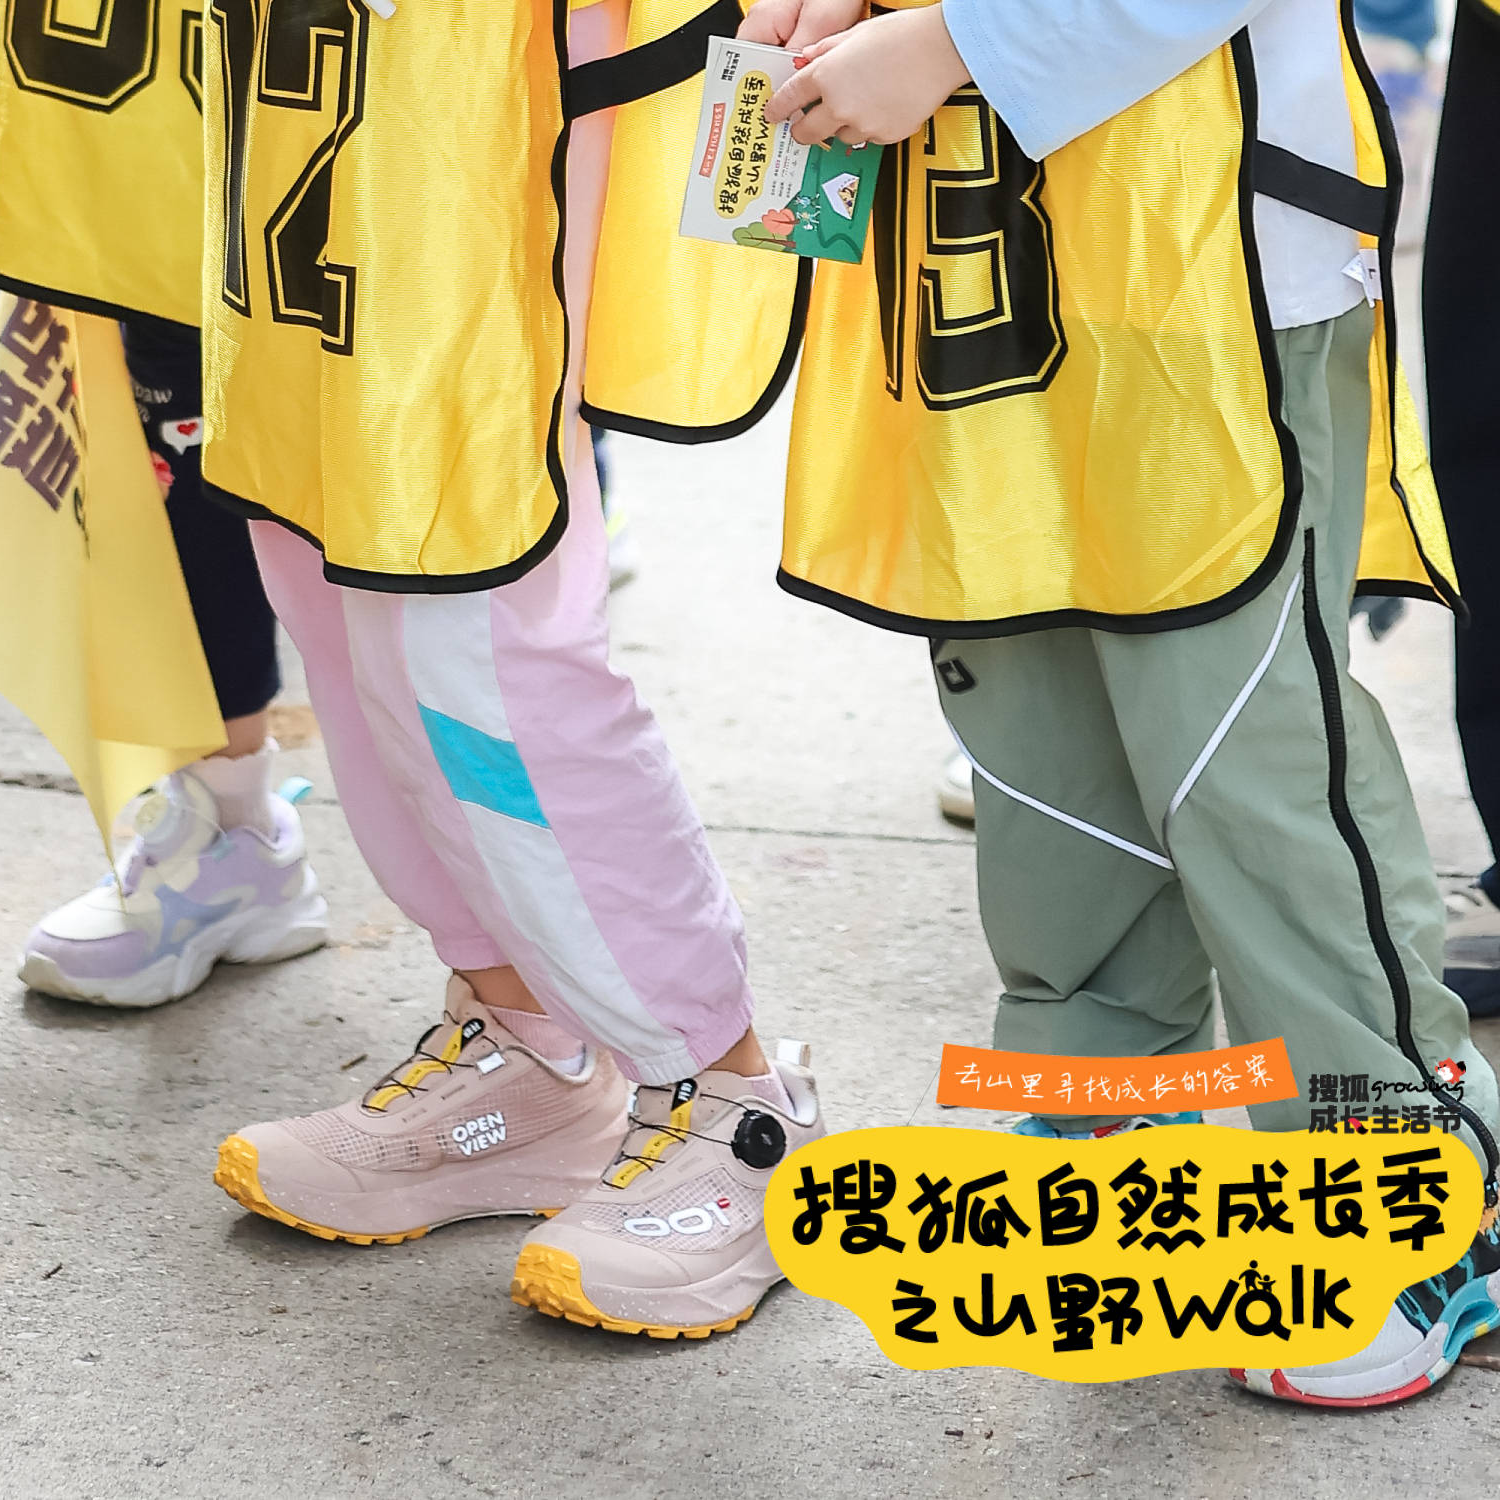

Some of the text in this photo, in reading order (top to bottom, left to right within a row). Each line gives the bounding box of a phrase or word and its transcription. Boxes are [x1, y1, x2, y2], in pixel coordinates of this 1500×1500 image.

[718, 75, 767, 214] 搜狐自然成长季
[451, 1110, 506, 1143] OPEN
[458, 1125, 508, 1157] VIEW
